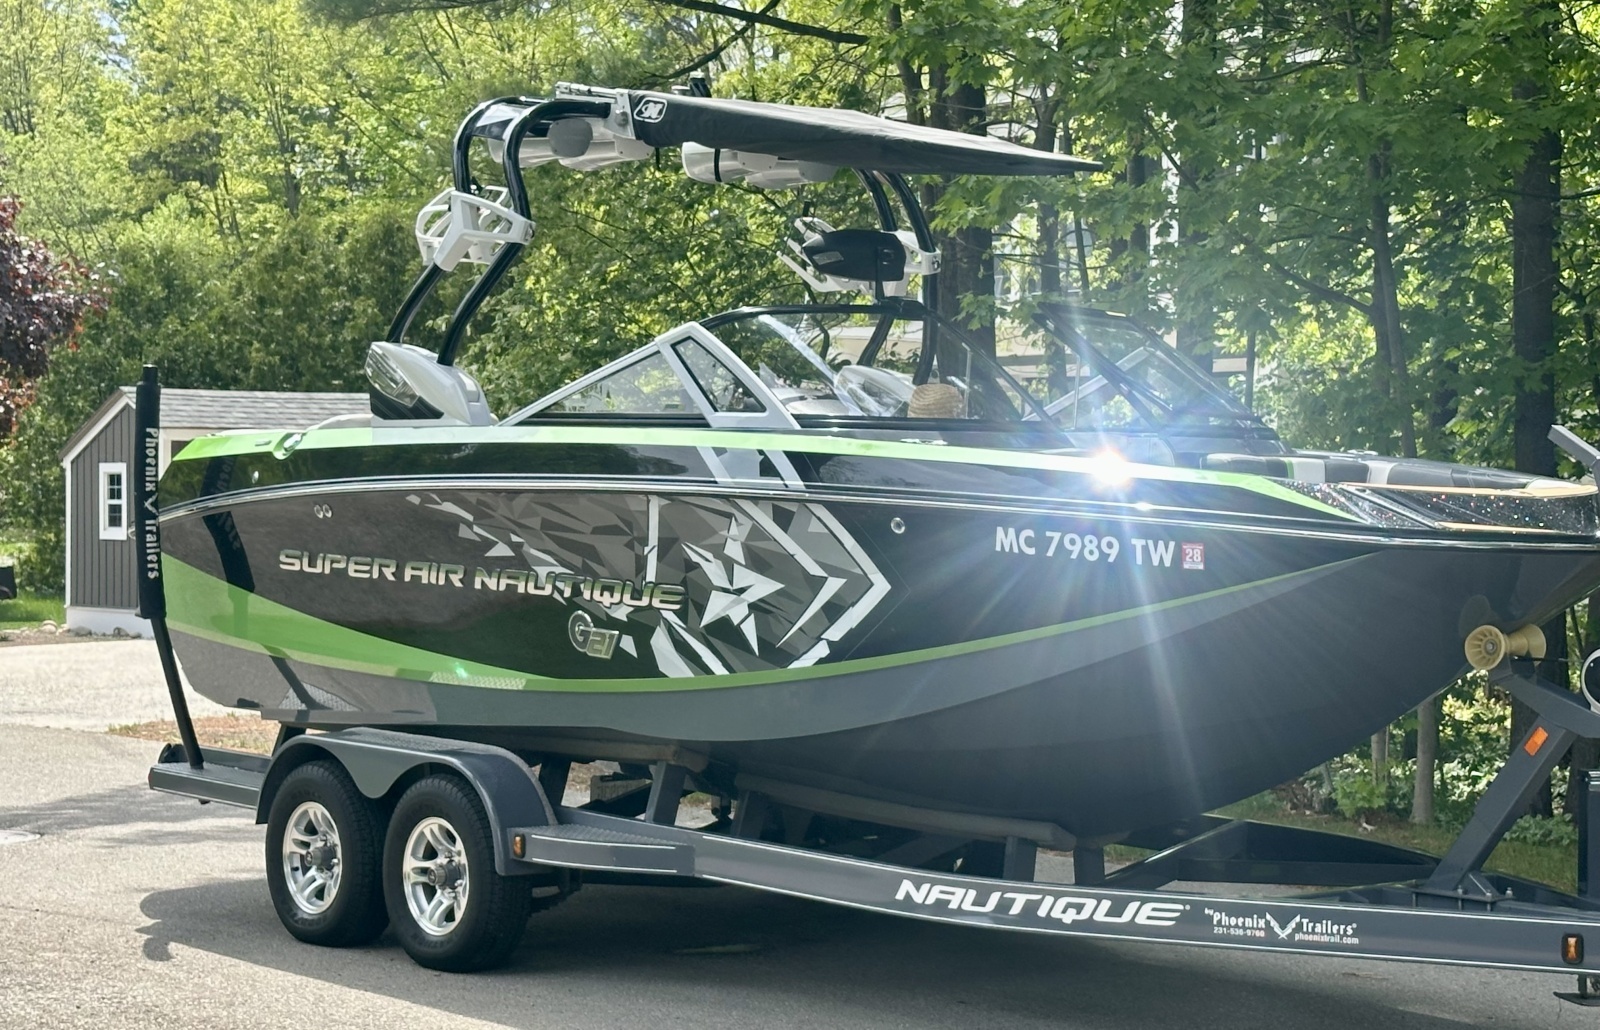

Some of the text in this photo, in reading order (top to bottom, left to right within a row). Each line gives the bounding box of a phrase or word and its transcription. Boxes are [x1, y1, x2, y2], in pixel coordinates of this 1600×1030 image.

[145, 427, 160, 579] Phoenix Trailers
[995, 526, 1176, 567] MC 7989 TW
[1185, 548, 1202, 562] 28
[279, 549, 686, 611] SUPER AIR NAUTIQUE
[568, 609, 620, 660] G21
[895, 879, 1185, 926] NAUTIQUE
[1213, 911, 1266, 929] Phoenix
[1295, 932, 1359, 944] phoenixtrail.com
